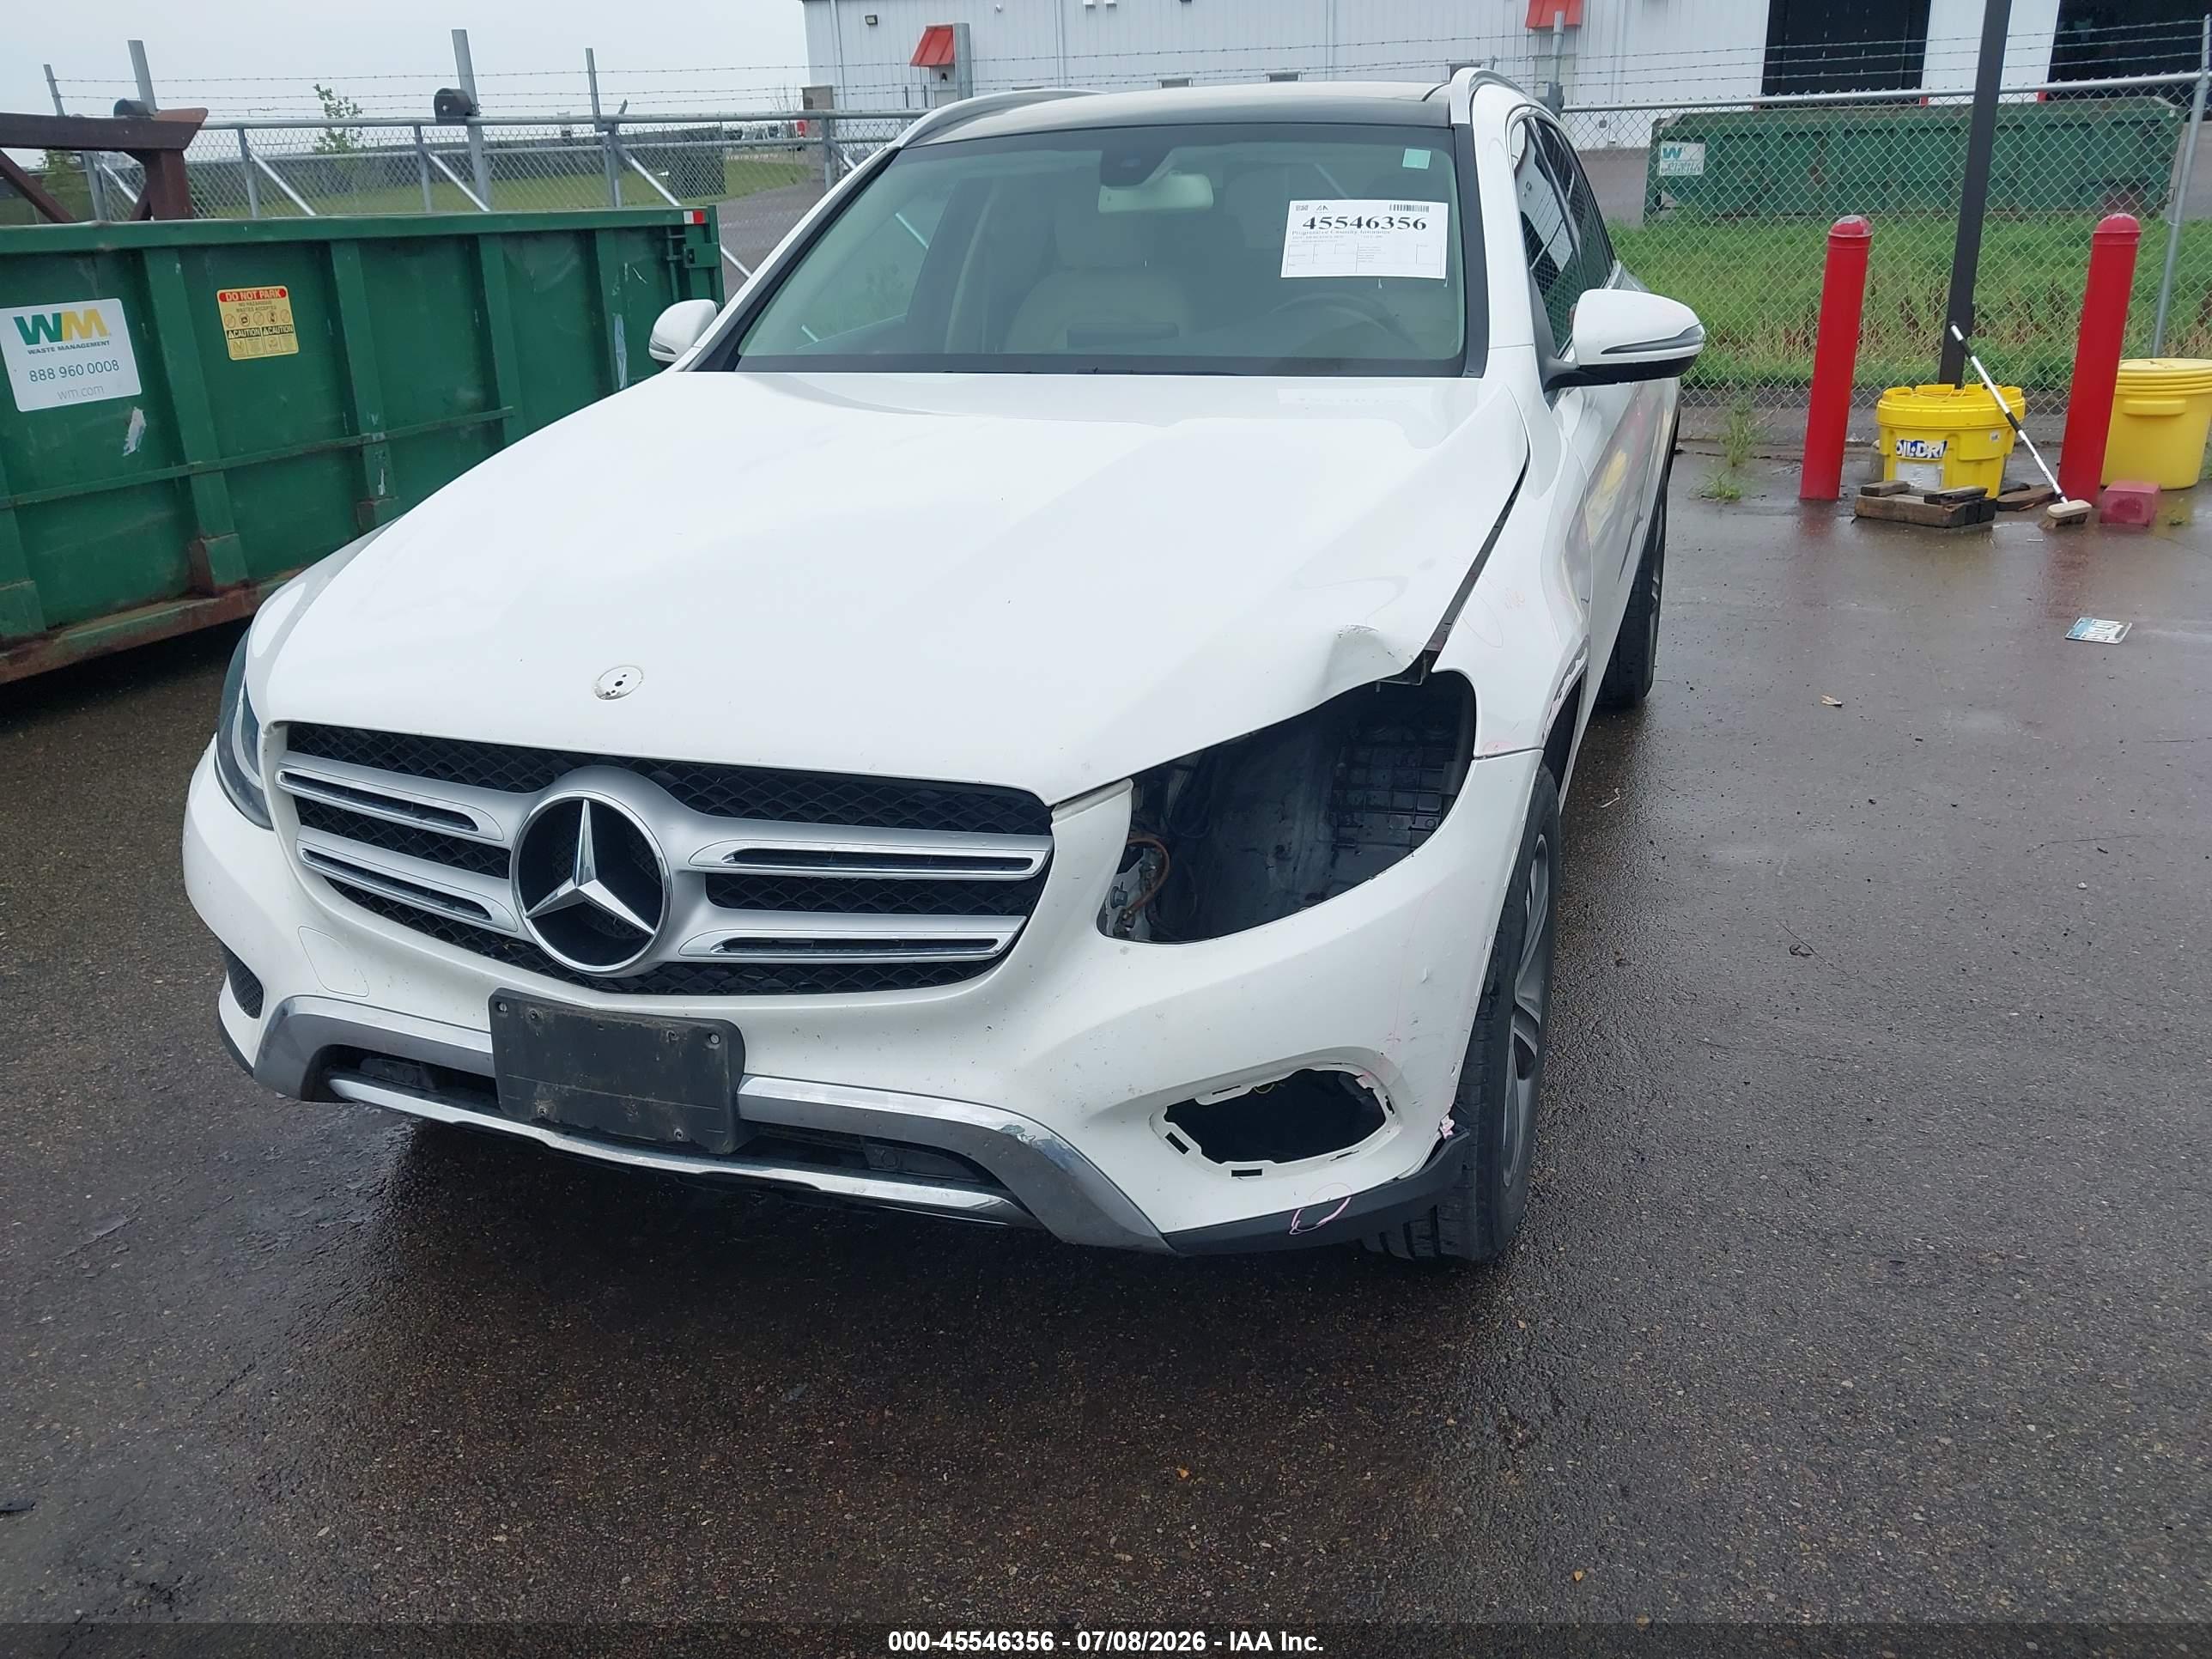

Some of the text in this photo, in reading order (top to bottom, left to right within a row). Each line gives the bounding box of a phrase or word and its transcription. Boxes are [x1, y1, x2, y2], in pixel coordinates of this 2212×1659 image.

[1303, 216, 1427, 231] 45546356
[226, 289, 280, 302] DO NOT PARK
[13, 308, 110, 346] WM
[234, 328, 260, 337] CAUTION
[268, 325, 293, 335] CAUTION
[27, 340, 110, 356] WASTE MANAGEMENT
[29, 359, 119, 382] 888 960 0008
[57, 385, 105, 400] wm.com
